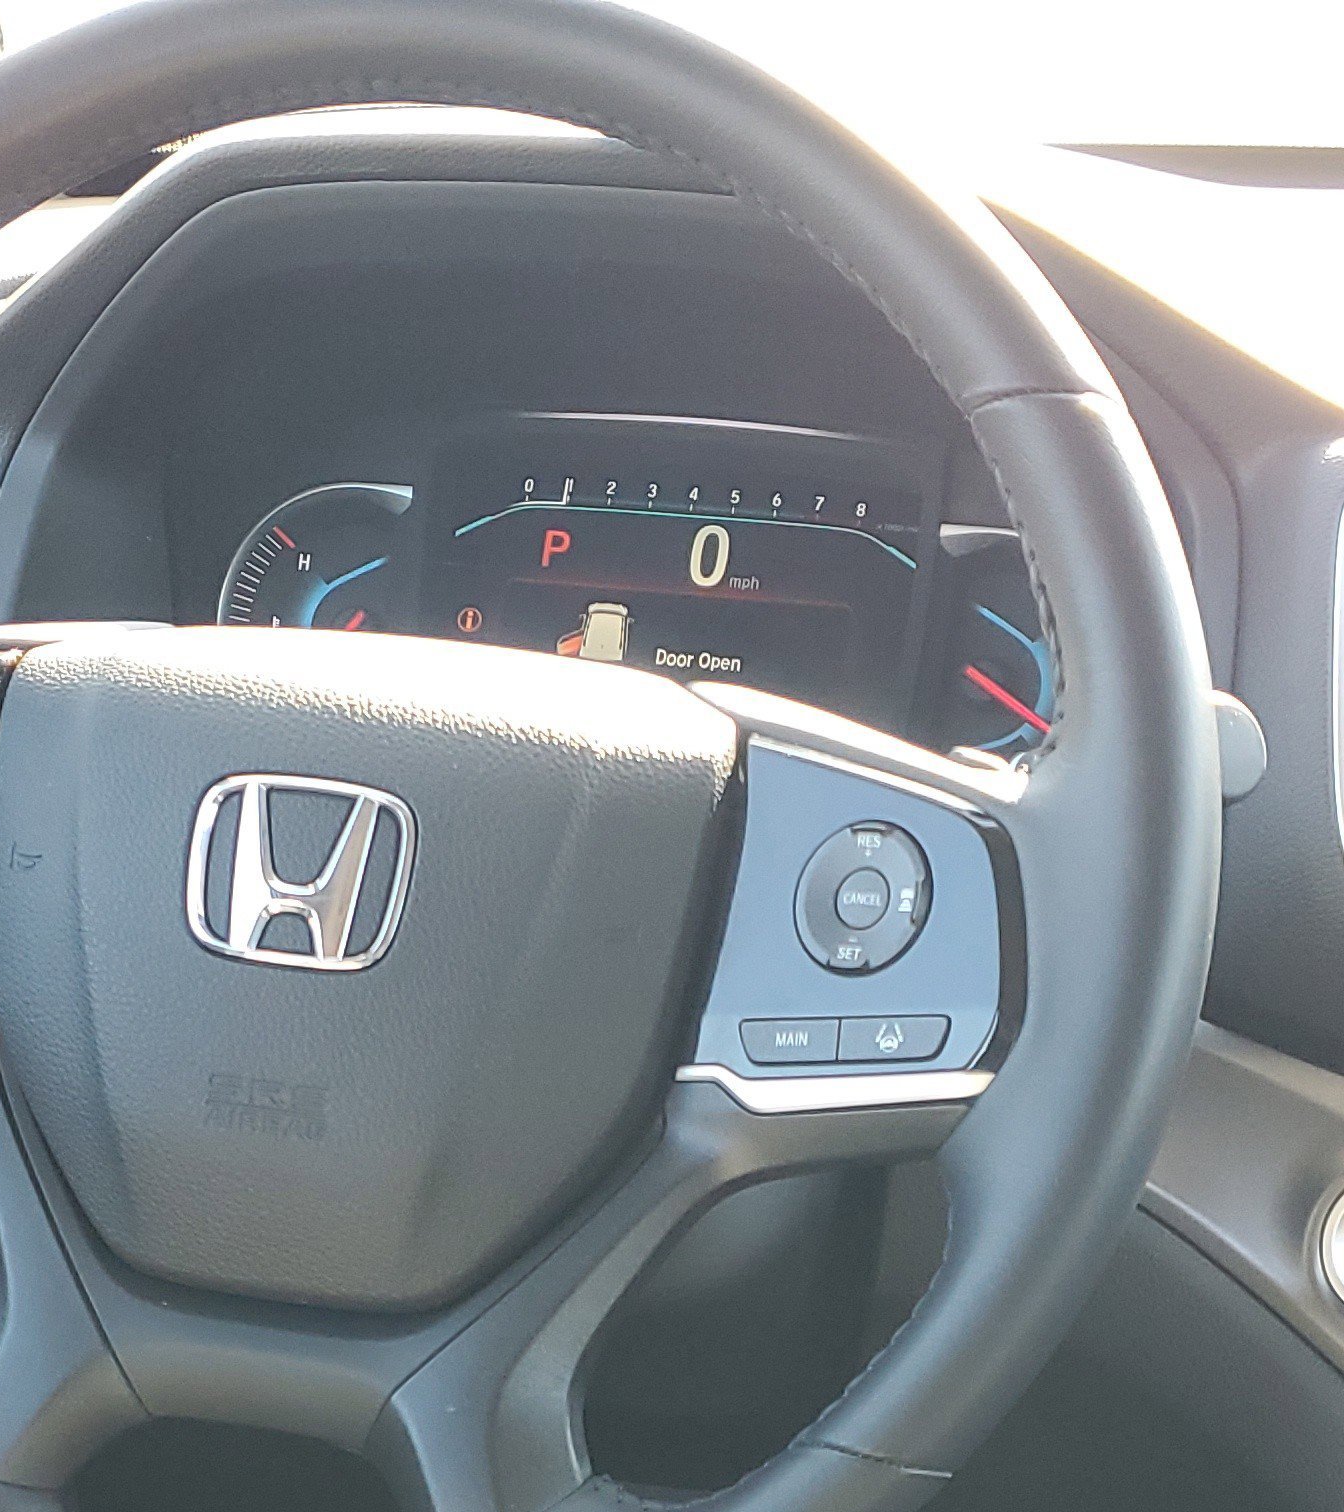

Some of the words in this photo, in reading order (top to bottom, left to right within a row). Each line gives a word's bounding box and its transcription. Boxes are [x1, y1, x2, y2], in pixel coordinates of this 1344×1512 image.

[524, 478, 535, 493] 0
[606, 480, 618, 496] 2
[646, 483, 658, 498] 3
[688, 486, 699, 501] 4
[730, 490, 741, 504] 5
[772, 493, 782, 507] 6
[814, 496, 825, 511] 7
[856, 503, 867, 518] 8
[541, 529, 572, 568] P
[297, 553, 311, 571] H
[688, 525, 731, 588] 0
[729, 575, 760, 592] mph
[655, 647, 695, 671] Door
[698, 651, 742, 673] Open
[857, 834, 882, 850] RES
[843, 893, 882, 907] CANCEL
[837, 947, 862, 962] SET
[775, 1031, 809, 1048] MAIN
